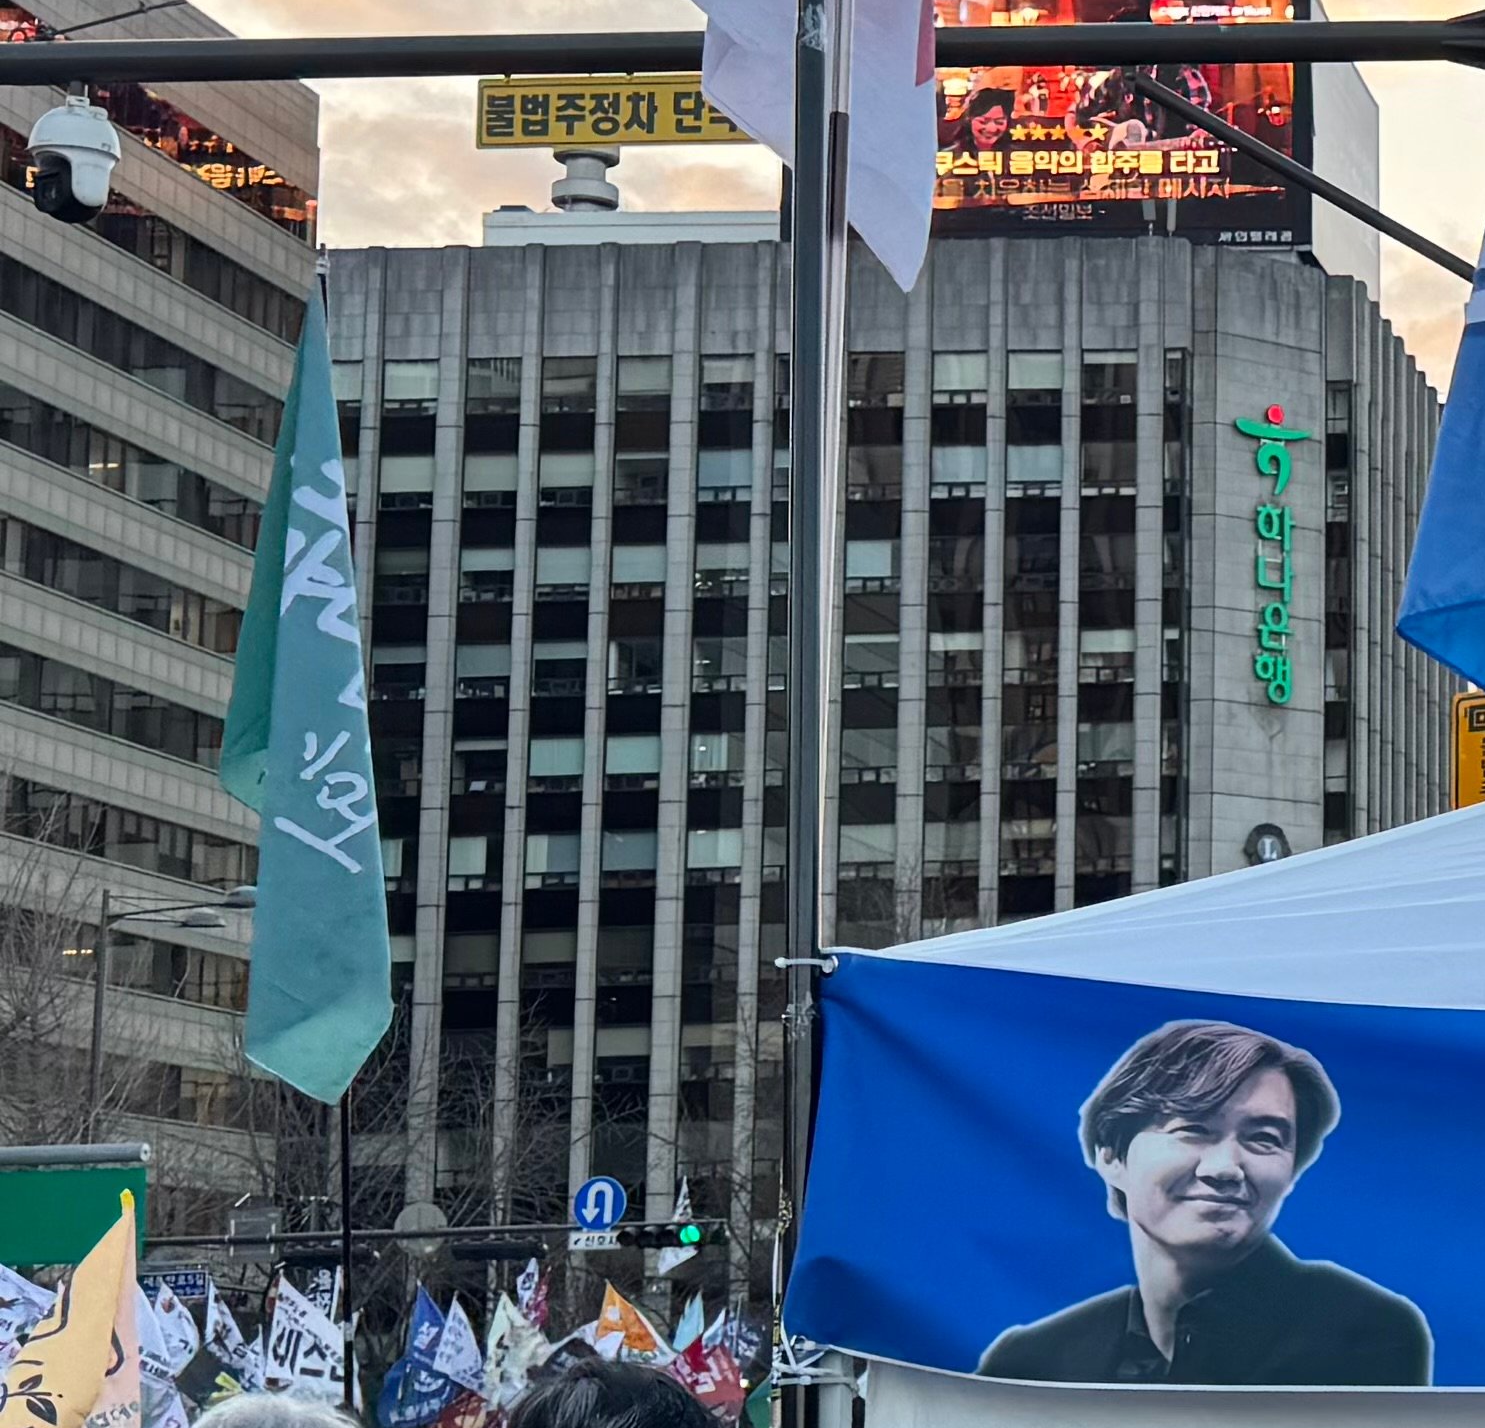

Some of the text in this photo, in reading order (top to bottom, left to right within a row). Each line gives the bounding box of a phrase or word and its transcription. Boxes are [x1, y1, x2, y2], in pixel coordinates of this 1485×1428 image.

[486, 91, 658, 137] 불법주정차
[1009, 150, 1083, 175] 음악의
[1170, 150, 1219, 173] 타고
[1254, 503, 1296, 704] 하나은행
